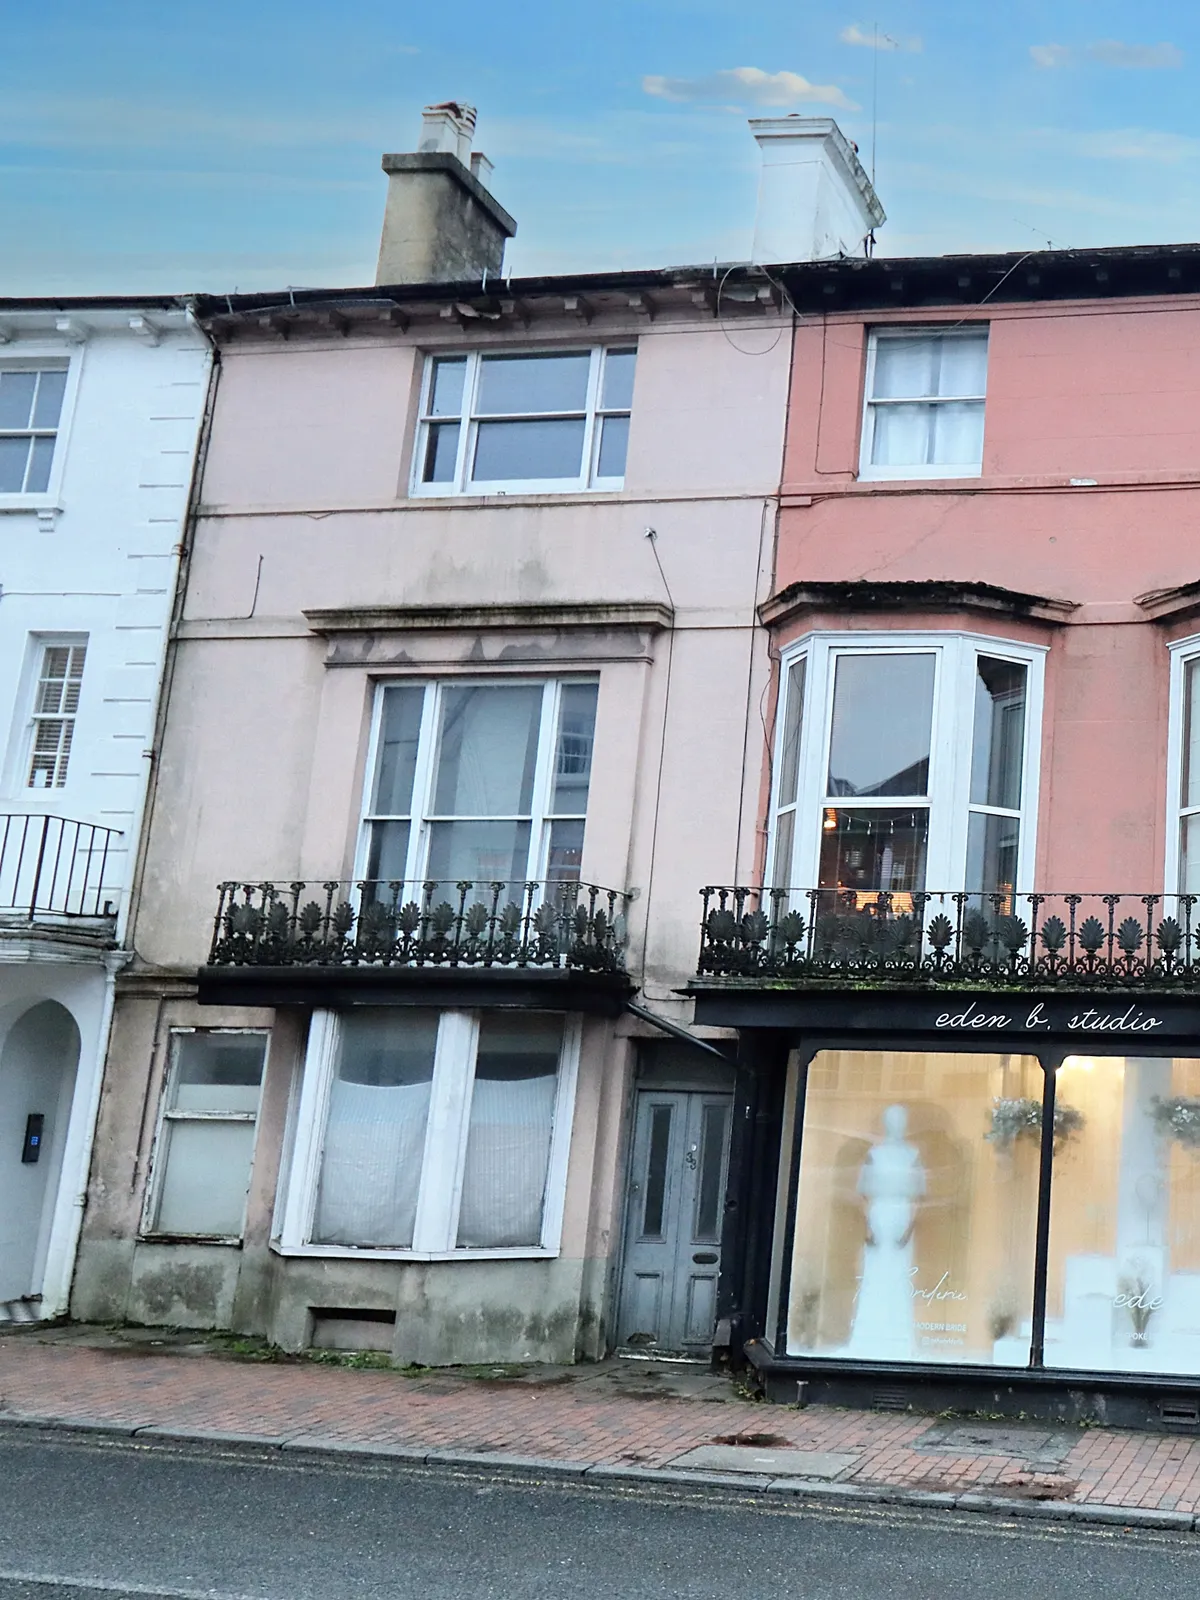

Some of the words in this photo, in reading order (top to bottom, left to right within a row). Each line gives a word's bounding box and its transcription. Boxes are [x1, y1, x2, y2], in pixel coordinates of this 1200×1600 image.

[935, 1001, 1012, 1028] eden
[1025, 1002, 1050, 1031] b.
[1067, 1004, 1163, 1031] studio
[1112, 1283, 1164, 1310] ede
[945, 1323, 967, 1333] BRIDE
